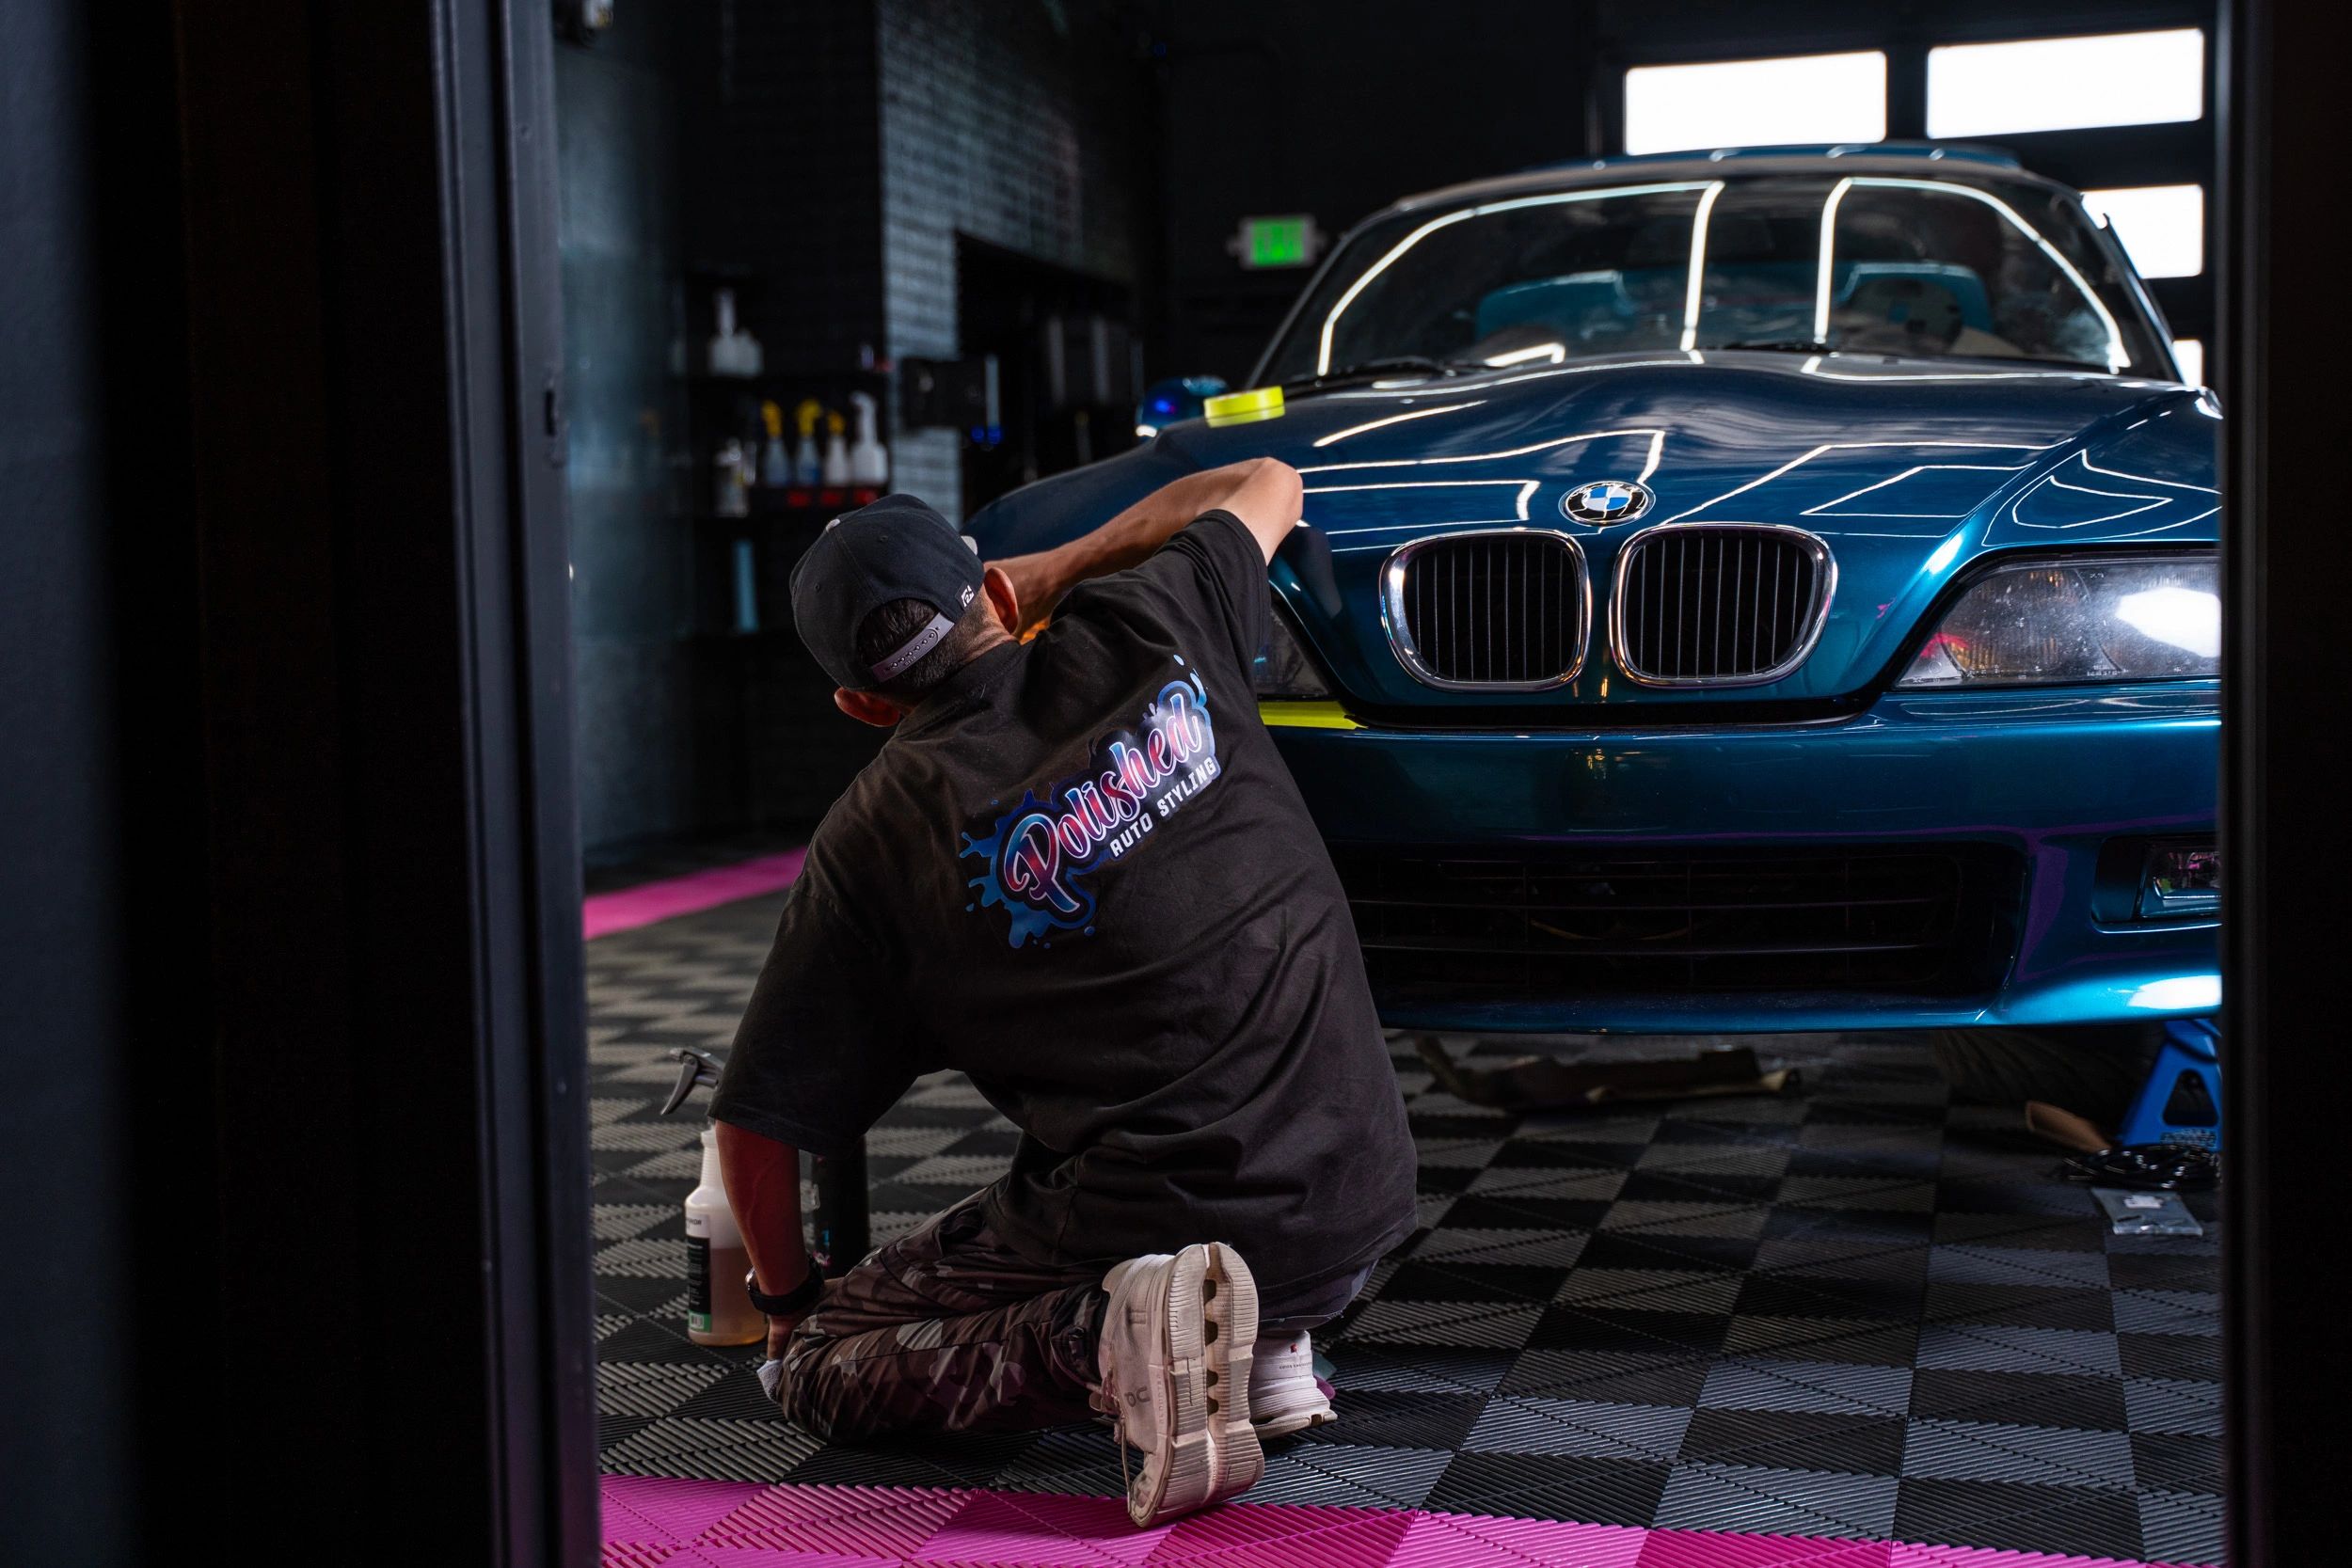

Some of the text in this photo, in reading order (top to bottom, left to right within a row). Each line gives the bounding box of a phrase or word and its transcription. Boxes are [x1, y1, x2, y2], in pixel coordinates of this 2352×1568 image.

[1004, 693, 1202, 912] Polished
[1109, 757, 1216, 858] AUTO STYLING
